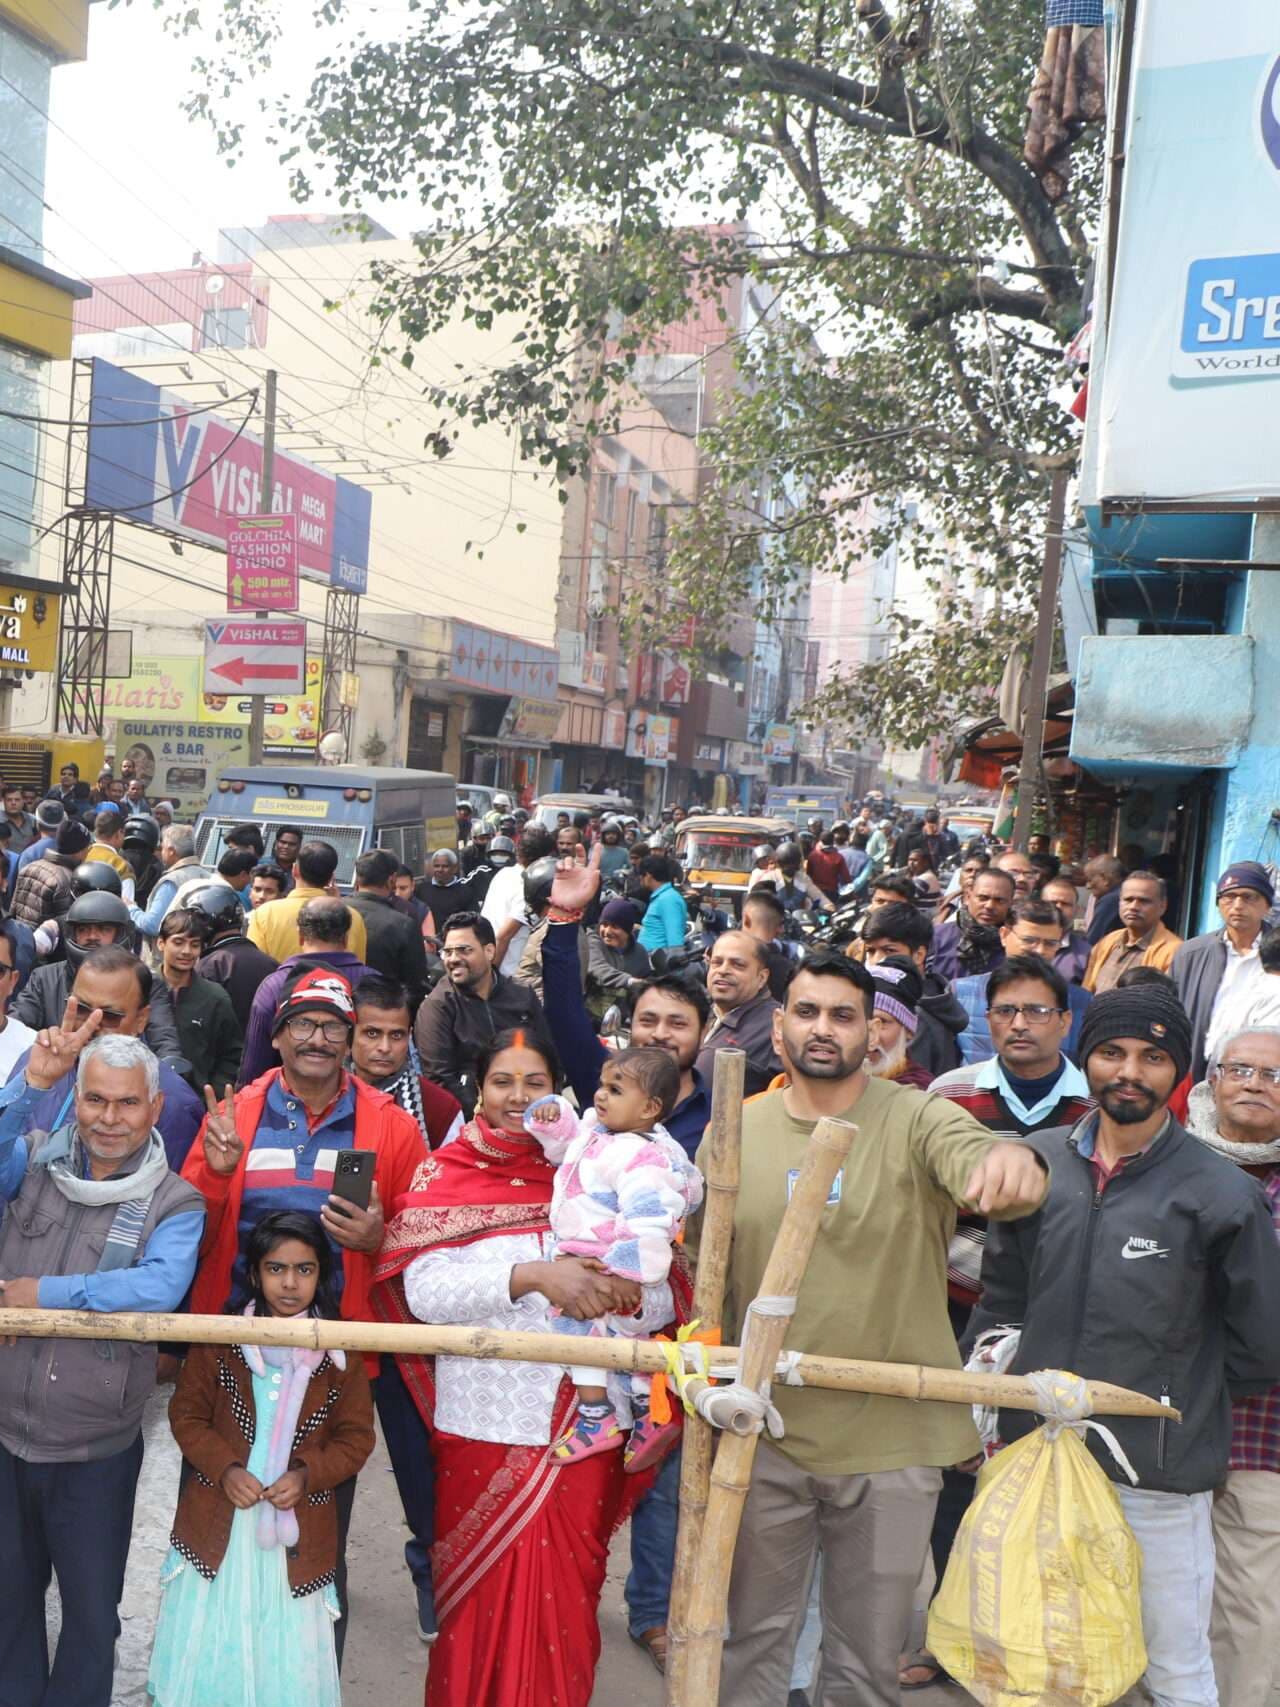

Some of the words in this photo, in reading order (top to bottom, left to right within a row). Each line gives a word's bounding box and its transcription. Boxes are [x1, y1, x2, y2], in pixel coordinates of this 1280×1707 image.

[1195, 354, 1280, 370] World
[301, 493, 326, 521] MEGA
[299, 520, 325, 546] MART
[231, 543, 291, 556] FASHION
[235, 556, 287, 570] STUDIO
[229, 628, 279, 641] VISHAL
[1, 647, 30, 663] MALL
[124, 724, 184, 737] GULATI'S
[188, 726, 243, 739] RESTRO
[162, 742, 172, 754] &
[177, 743, 205, 756] BAR
[1129, 1236, 1158, 1250] NIKE
